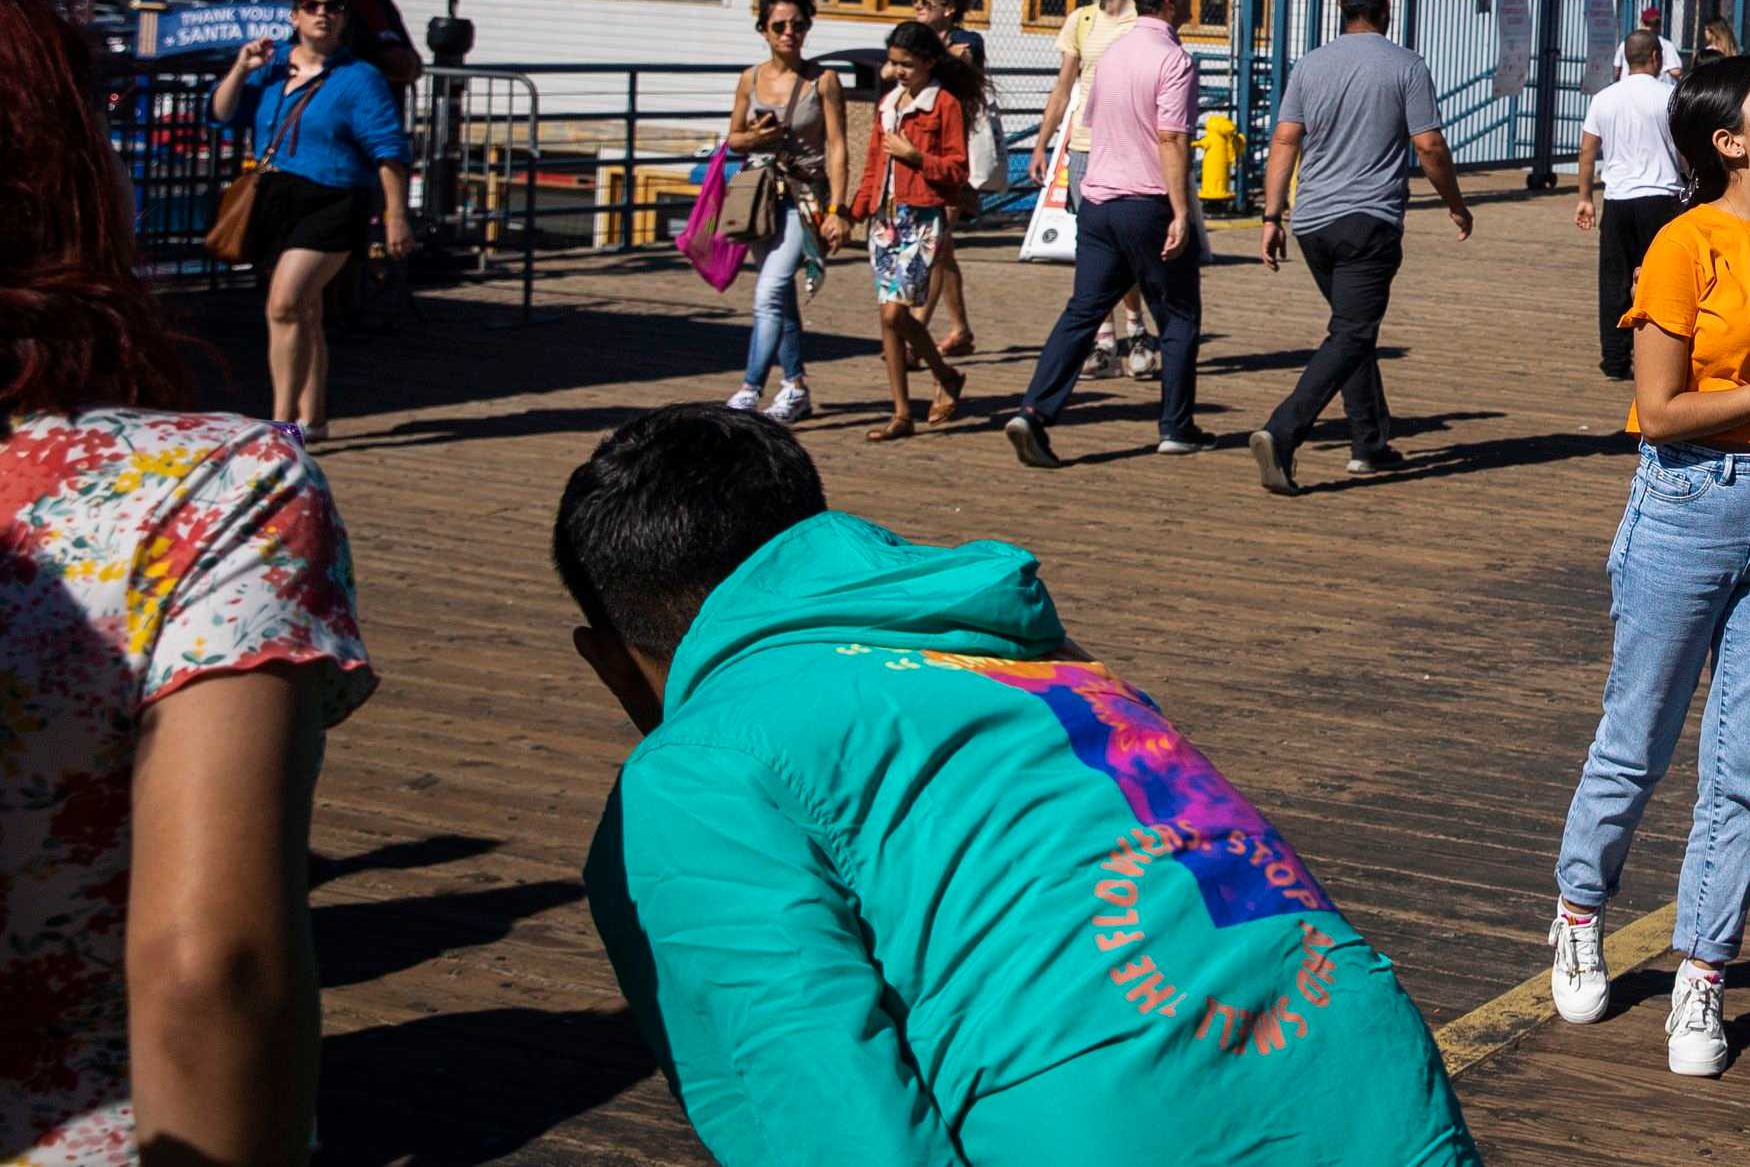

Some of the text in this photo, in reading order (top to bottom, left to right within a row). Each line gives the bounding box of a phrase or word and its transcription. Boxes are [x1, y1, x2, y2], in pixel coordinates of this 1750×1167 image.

[176, 23, 242, 46] SANTA
[180, 7, 235, 26] THANK
[239, 6, 274, 22] YOU
[1227, 830, 1319, 909] STOP
[1109, 955, 1189, 1016] THE
[1298, 919, 1337, 1008] AND
